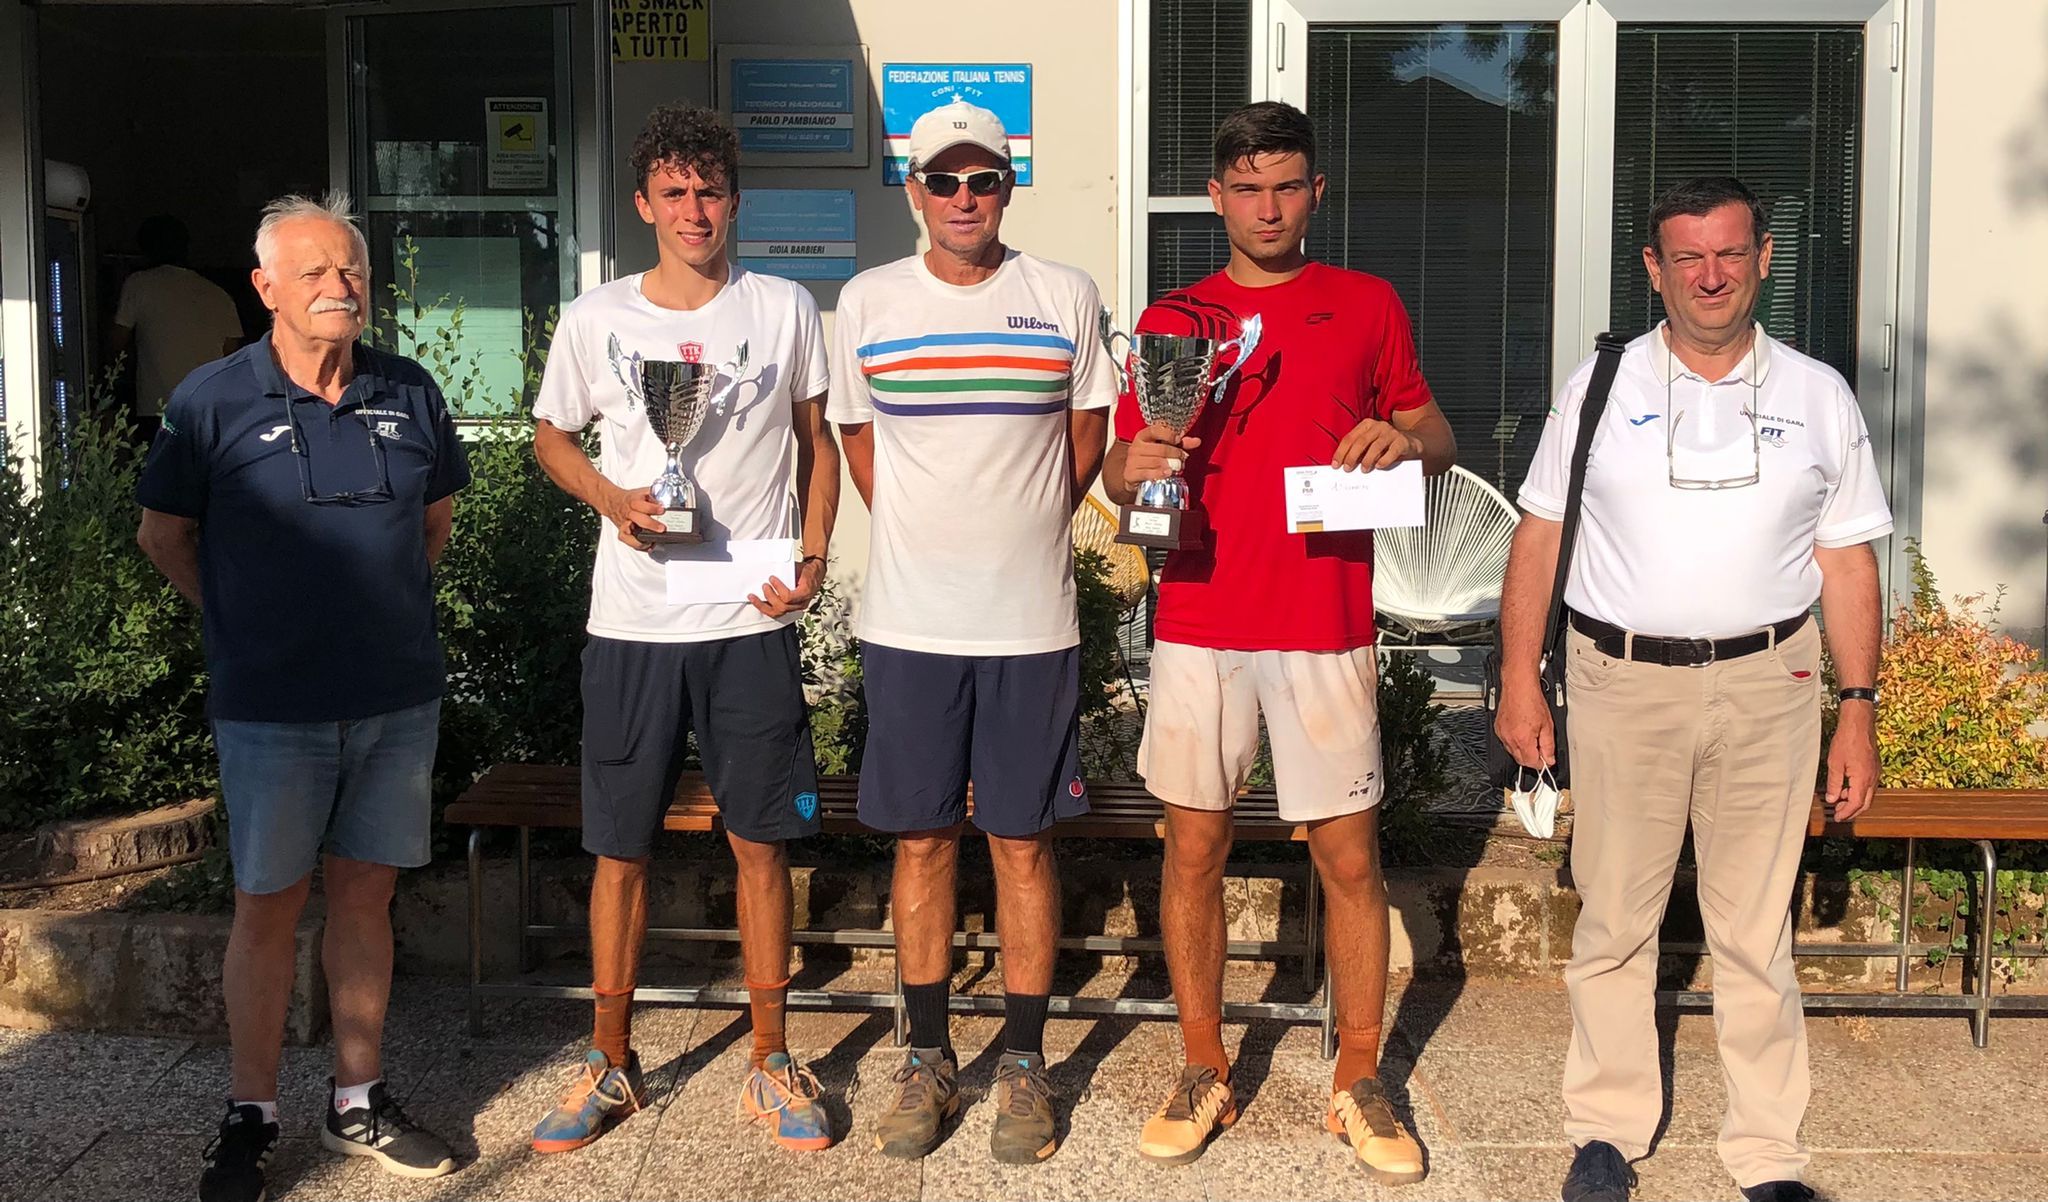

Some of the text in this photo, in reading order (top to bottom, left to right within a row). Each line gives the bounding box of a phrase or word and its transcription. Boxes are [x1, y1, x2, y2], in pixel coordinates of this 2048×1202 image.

[612, 12, 688, 34] APERTO
[612, 36, 688, 58] A TUTTI
[888, 70, 1025, 83] FEDERAZIONE ITALIANA TENNIS
[931, 85, 955, 97] CONI
[964, 86, 983, 97] FIT
[750, 115, 837, 126] PAOLO PAMBIANCO
[768, 244, 825, 255] GIOIA BARBIERI
[1006, 315, 1059, 333] Wilson
[1785, 418, 1805, 428] GARA
[1760, 426, 1786, 437] FIT
